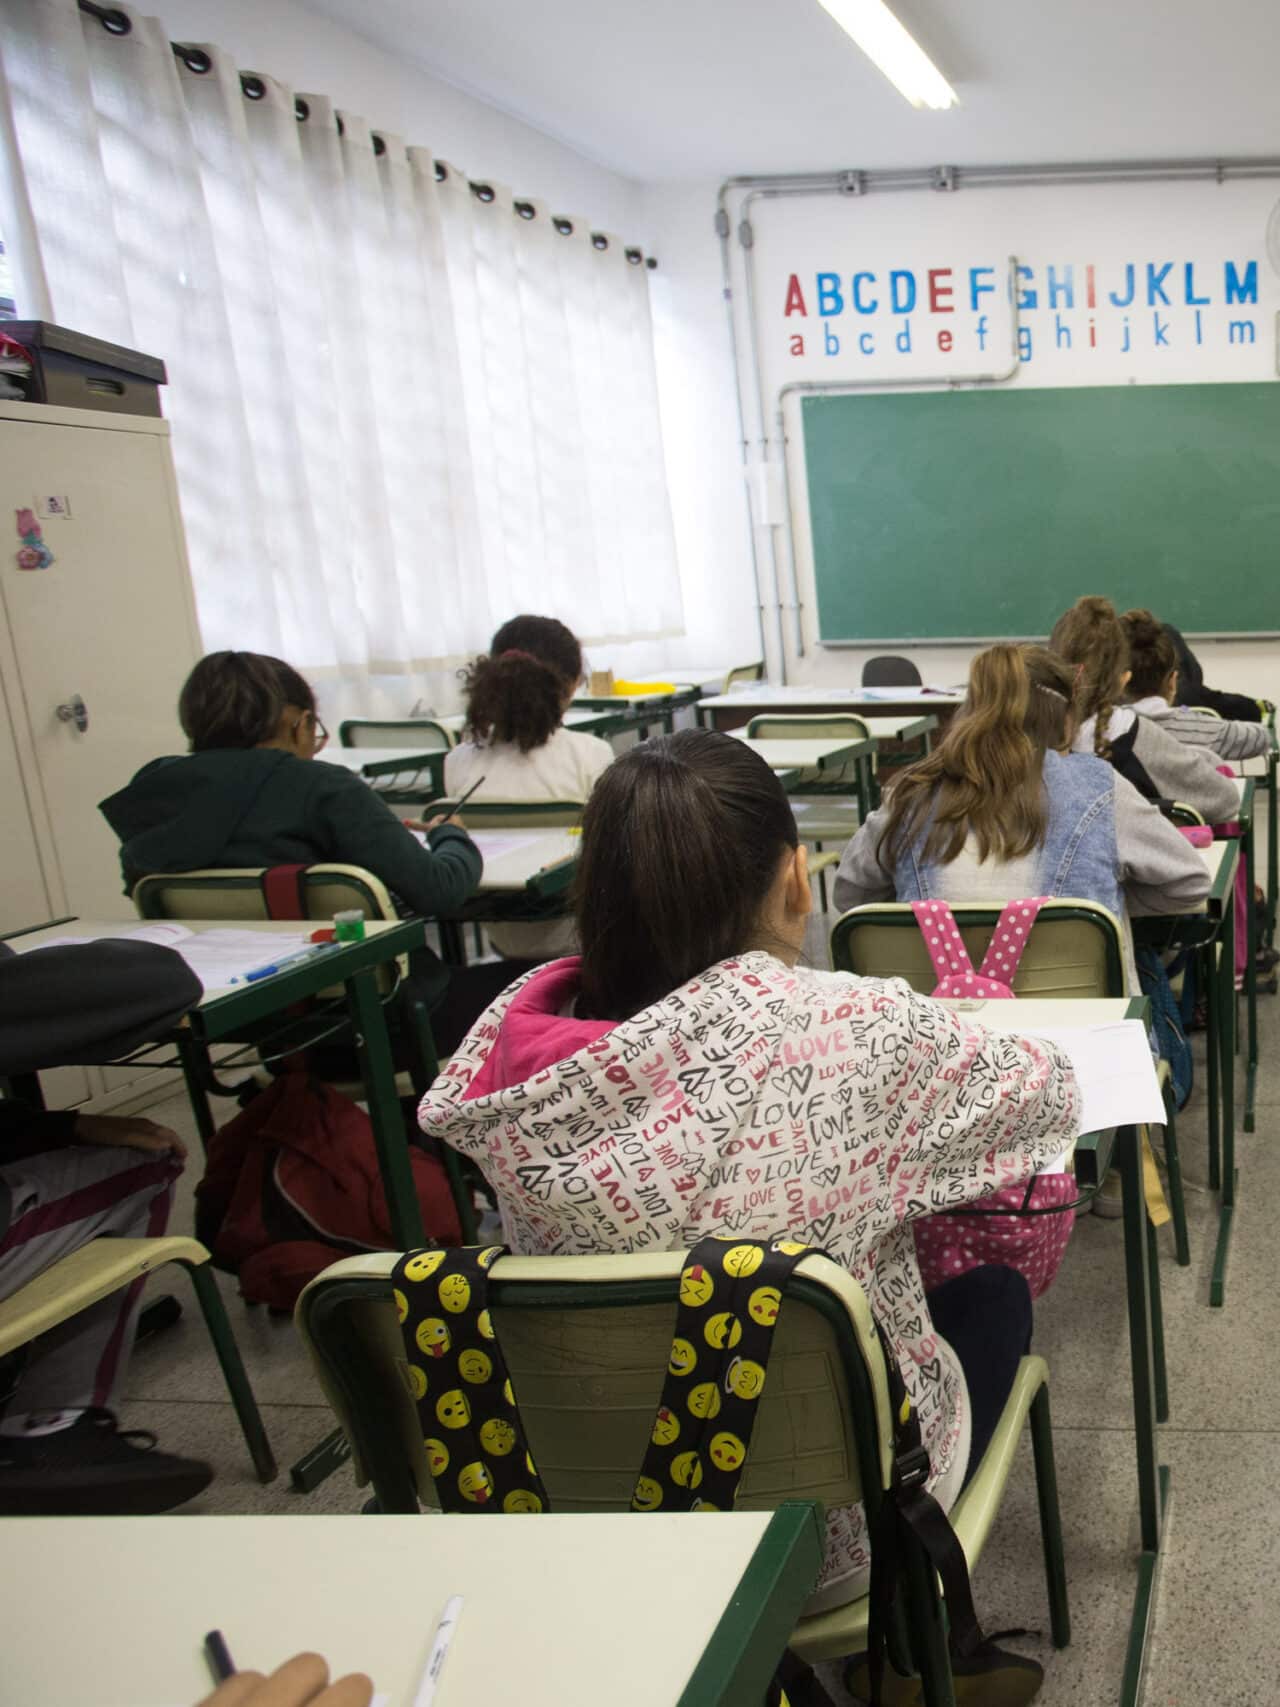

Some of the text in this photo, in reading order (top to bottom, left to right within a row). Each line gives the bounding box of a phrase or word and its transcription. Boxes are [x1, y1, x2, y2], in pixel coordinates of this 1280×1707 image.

[784, 274, 809, 318] A
[816, 272, 845, 317] B
[851, 271, 879, 316] C
[888, 268, 917, 315] D
[928, 268, 956, 314] E
[968, 266, 996, 312] F
[1047, 264, 1074, 310] H
[1087, 264, 1098, 309] I
[1109, 263, 1135, 308] J
[1146, 261, 1174, 307] K
[1184, 261, 1212, 306] L
[1223, 260, 1259, 305] M
[708, 1006, 755, 1051] LOVE
[784, 1028, 848, 1065] LOVE
[849, 1020, 869, 1049] LOVE
[623, 1034, 656, 1063] LOVE
[666, 1032, 692, 1067] LOVE
[735, 1036, 769, 1068] LOVE
[918, 1039, 947, 1091] LOVE
[640, 1052, 685, 1112] LOVE
[702, 1045, 754, 1107] LOVE
[818, 1058, 857, 1081] LOVE
[936, 1064, 968, 1088] LOVE
[975, 1050, 1003, 1110] LOVE
[579, 1076, 611, 1111] LOVE
[751, 1092, 826, 1129] LOVE
[858, 1083, 885, 1124] LOVE
[919, 1084, 939, 1113] LOVE
[552, 1105, 605, 1148] LOVE
[642, 1101, 698, 1142] LOVE
[809, 1104, 856, 1147] LOVE
[884, 1100, 909, 1139] LOVE
[931, 1086, 968, 1150] LOVE
[983, 1117, 1005, 1145] LOVE
[504, 1122, 533, 1163] LOVE
[579, 1135, 618, 1167] LOVE
[608, 1115, 651, 1167] LOVE
[653, 1140, 685, 1171] LOVE
[727, 1128, 785, 1157] OVE
[790, 1118, 809, 1157] LOVE
[844, 1126, 881, 1153] LOVE
[544, 1140, 597, 1206] LOVE
[764, 1149, 825, 1184] LOVE
[947, 1164, 967, 1204] LOVE
[1000, 1154, 1017, 1185] VE
[591, 1160, 641, 1225] LOVE
[634, 1183, 673, 1219] LOVE
[744, 1185, 777, 1212] LOVE
[784, 1176, 808, 1230] LOVE
[807, 1173, 873, 1220] LOVE
[838, 1197, 877, 1225] LOVE
[587, 1204, 619, 1237] LOVE
[881, 1262, 918, 1307] LOVE
